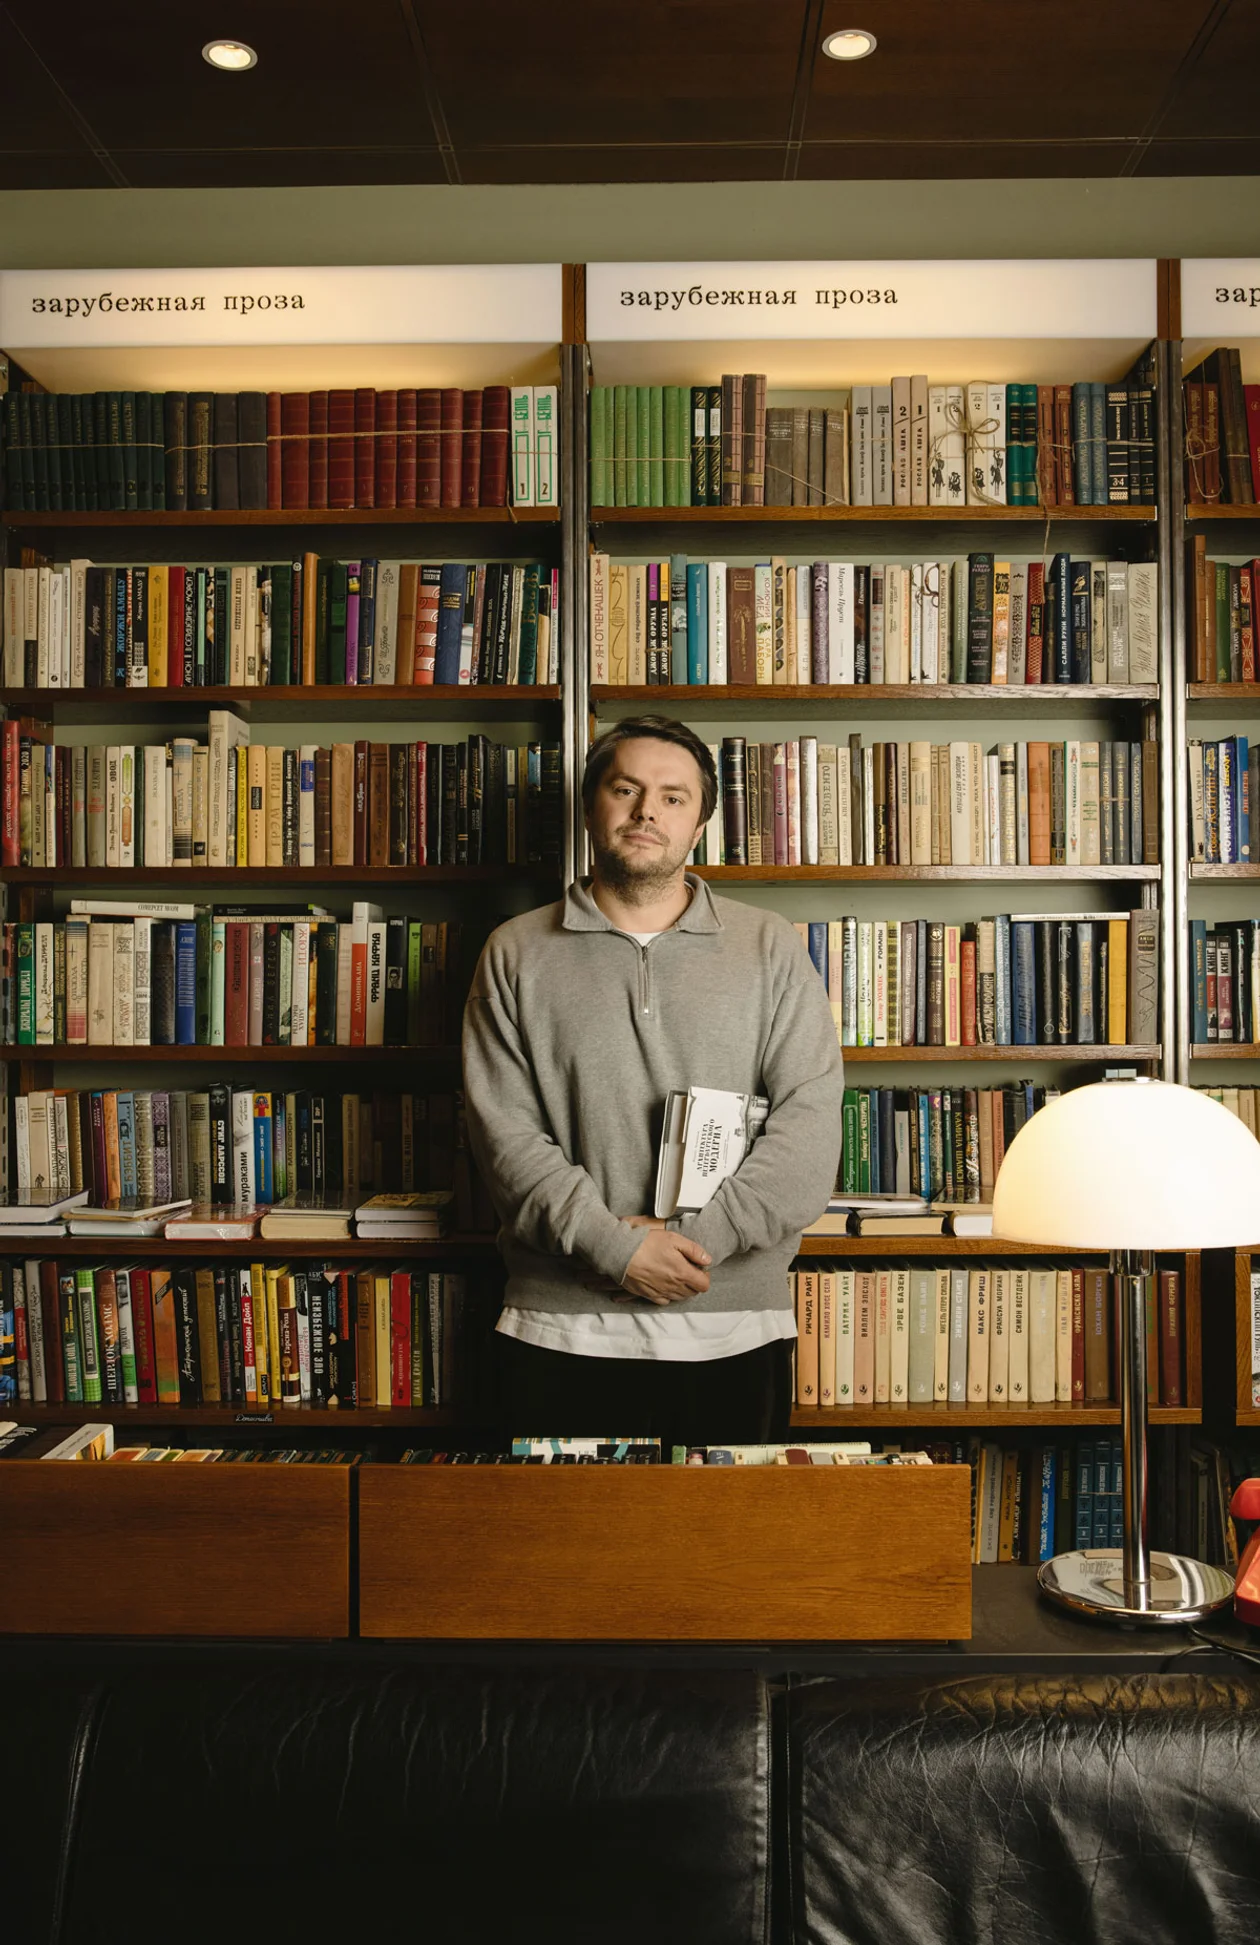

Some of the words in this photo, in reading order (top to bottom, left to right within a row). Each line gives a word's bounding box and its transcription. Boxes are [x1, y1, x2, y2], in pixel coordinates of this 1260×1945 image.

[32, 291, 206, 318] зарубежная
[223, 294, 306, 315] проза
[620, 286, 798, 311] зарубежная
[815, 289, 898, 309] проза
[900, 406, 907, 416] 2
[917, 404, 923, 415] 1
[519, 482, 526, 495] 1
[541, 482, 550, 495] 2
[116, 578, 125, 612] АМАДУ
[837, 567, 847, 596] Марсель
[1130, 568, 1154, 609] Ремарк
[594, 579, 604, 642] ОТЧЕНАШЕК
[763, 577, 771, 618] КОЛЮЧИЙ
[836, 597, 846, 624] Пруст
[116, 614, 125, 653] ЖОРЖИ
[650, 607, 658, 637] ОРУЭЛЛ
[661, 607, 669, 637] ОРУЭЛЛ
[594, 644, 605, 658] ЯН
[756, 637, 766, 680] ПАБОРН
[21, 751, 29, 767] 2020
[108, 760, 118, 783] ОВОД
[21, 768, 29, 795] ТИТАНИК
[271, 762, 280, 799] ГРИН
[271, 808, 280, 847] ГРЭМ
[298, 929, 307, 965] ЖЮТИ
[371, 932, 381, 967] КАФКА
[1206, 951, 1216, 974] КИНГ
[1220, 951, 1230, 974] КИНГ
[354, 961, 363, 1013] ДОМИНИКАНА
[371, 968, 379, 1003] ФРАНЦ
[860, 1101, 868, 1129] ЧЕСТЕРТОН
[954, 1111, 963, 1148] КАМИЛА
[217, 1120, 225, 1143] СТИГ
[122, 1141, 134, 1181] БЭББИТ
[709, 1125, 722, 1172] МОДЕРНА
[217, 1144, 226, 1184] ЛАРССОН
[240, 1151, 250, 1202] мураками
[955, 1150, 965, 1182] ШАМСИ
[805, 1275, 813, 1297] РАЙТ
[842, 1275, 850, 1295] УАЙТ
[861, 1276, 869, 1305] ЭЛСХОТ
[896, 1274, 905, 1304] БАЗЕН
[939, 1275, 948, 1295] СИЛЬВА
[977, 1276, 986, 1305] ФРИШ
[996, 1274, 1004, 1303] МОРИАК
[1014, 1274, 1023, 1308] ВЕСТДЕЙК
[1074, 1273, 1082, 1292] АЯЛА
[178, 1287, 194, 1324] детектив
[241, 1303, 251, 1326] Дойл
[805, 1299, 813, 1335] РИЧАРД
[842, 1303, 850, 1335] ПАТРИК
[939, 1296, 947, 1314] ОТЕРО
[1074, 1293, 1082, 1334] ФРАНСИСКО
[103, 1303, 114, 1341] ХОЛМС
[281, 1312, 291, 1355] Гарсиа-Роза
[311, 1295, 323, 1354] НЕИЗБЕЖНОЕ
[896, 1308, 905, 1333] ЭРВЕ
[939, 1314, 947, 1335] МИГЕЛЬ
[977, 1309, 985, 1335] МАКС
[996, 1304, 1004, 1336] ФРАНСУА
[1014, 1309, 1023, 1335] СИМОН
[1095, 1315, 1103, 1336] ЮХАН
[181, 1326, 196, 1383] Американский
[244, 1327, 253, 1353] Конан
[106, 1343, 117, 1390] ШЕРЛОК
[312, 1356, 323, 1375] ЗЛО
[413, 1350, 422, 1377] КРИСТИ
[413, 1379, 422, 1398] АГАТА
